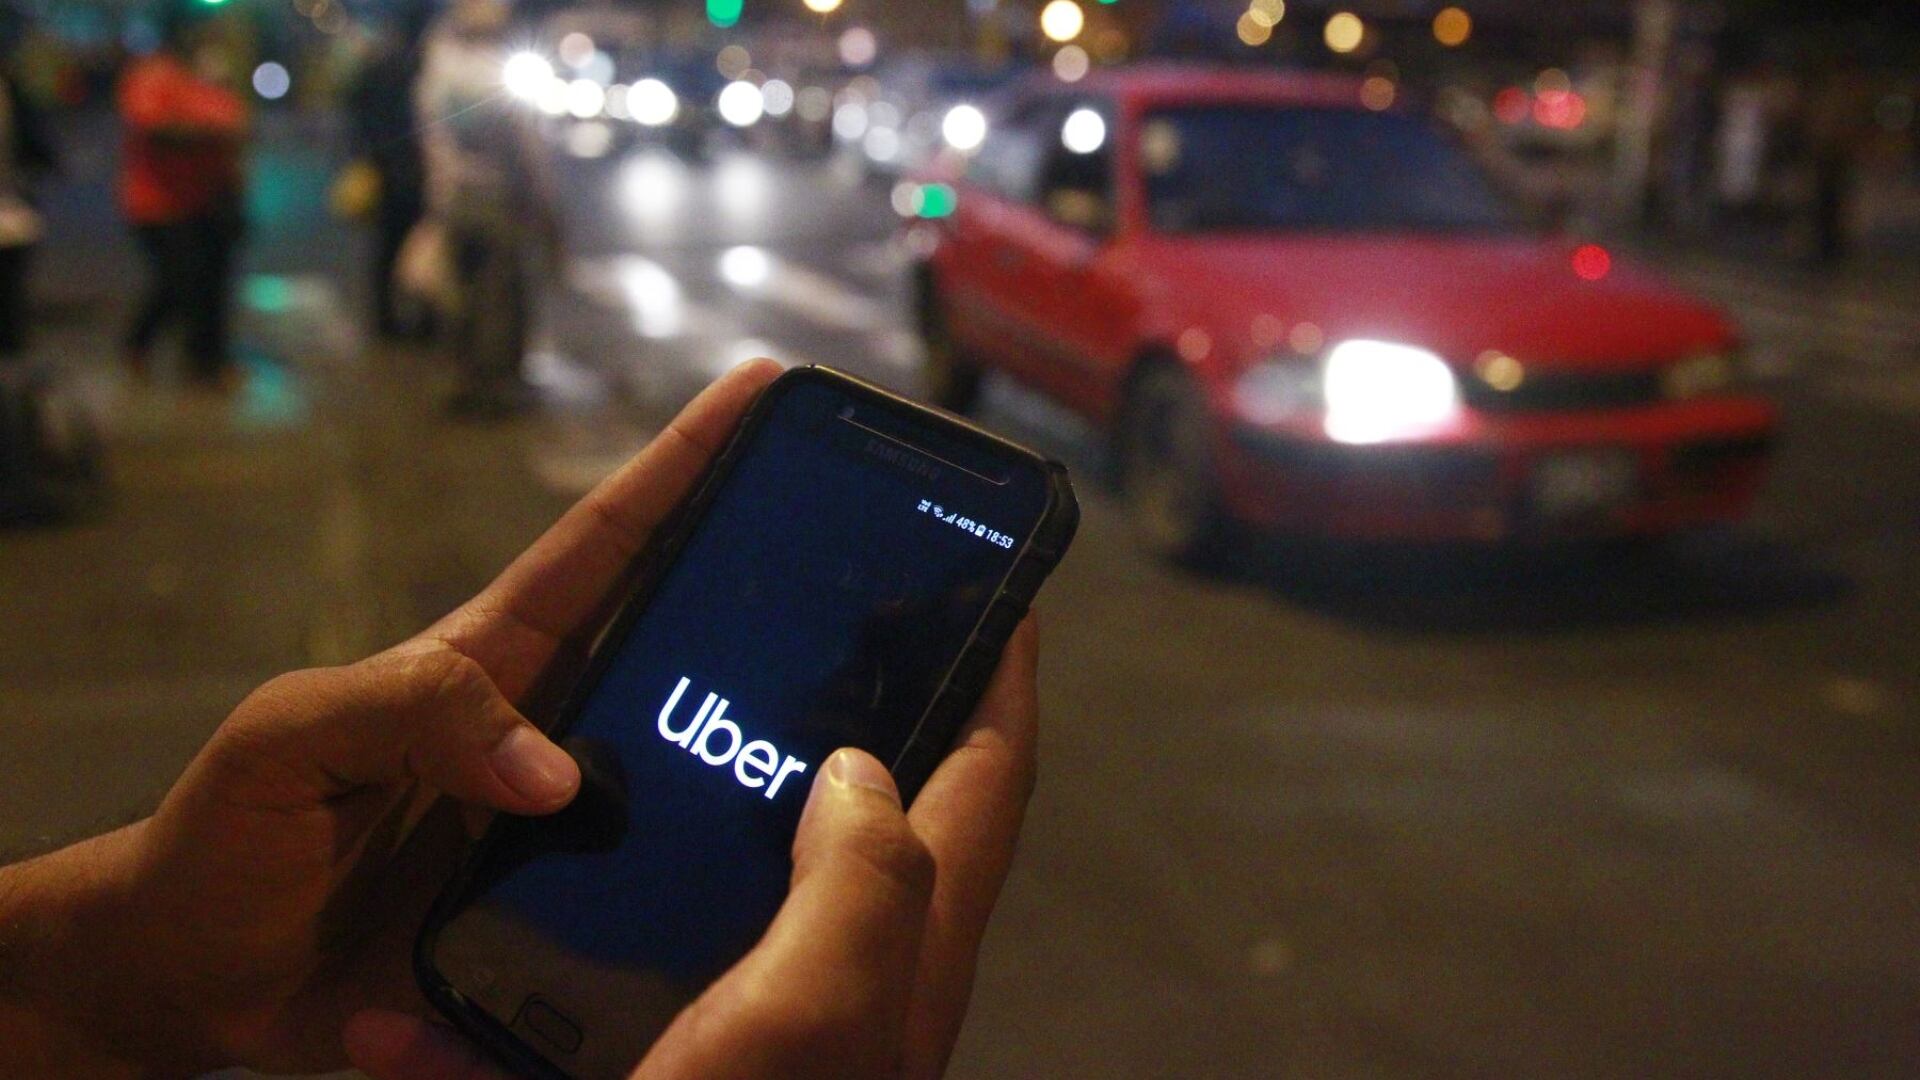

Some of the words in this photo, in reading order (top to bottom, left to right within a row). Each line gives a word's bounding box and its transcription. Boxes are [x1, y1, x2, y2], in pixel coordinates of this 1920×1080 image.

[956, 516, 977, 533] 48%
[986, 529, 1014, 549] 18:53
[657, 676, 808, 800] Uber
